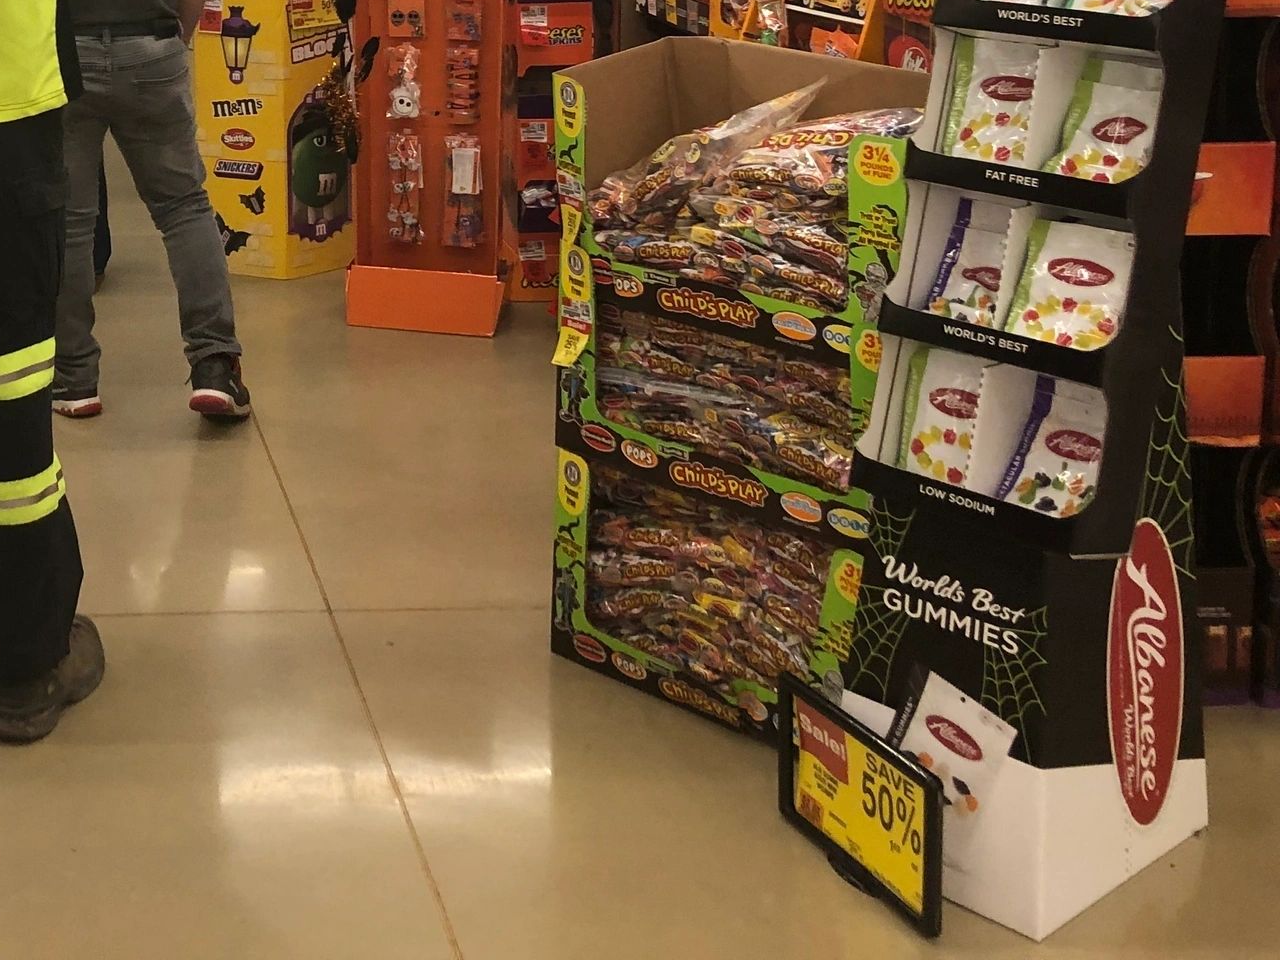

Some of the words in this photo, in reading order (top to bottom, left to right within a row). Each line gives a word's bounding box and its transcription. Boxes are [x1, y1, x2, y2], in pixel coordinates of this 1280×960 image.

[997, 9, 1050, 24] WORLD'S
[1053, 15, 1083, 27] BEST
[548, 25, 585, 38] ese's
[223, 134, 255, 144] Skittles
[216, 161, 257, 176] SNICKERS
[860, 161, 894, 173] POUNDS
[985, 169, 1006, 182] FAT
[1009, 172, 1039, 188] FREE
[615, 275, 637, 293] OPS
[719, 302, 757, 323] PLAY
[824, 329, 851, 344] DO
[943, 324, 996, 346] WORLD'S
[999, 337, 1028, 354] BEST
[625, 444, 654, 466] POPS
[727, 480, 765, 504] PLAY
[920, 484, 946, 501] LOW
[948, 492, 995, 516] SODIUM
[882, 555, 965, 603] World's
[972, 588, 1026, 624] Best
[883, 588, 1019, 654] GUMMIES
[1126, 556, 1167, 801] Albanese
[799, 712, 847, 761] Sale!
[865, 751, 915, 803] SAVE
[862, 769, 921, 856] 50%
